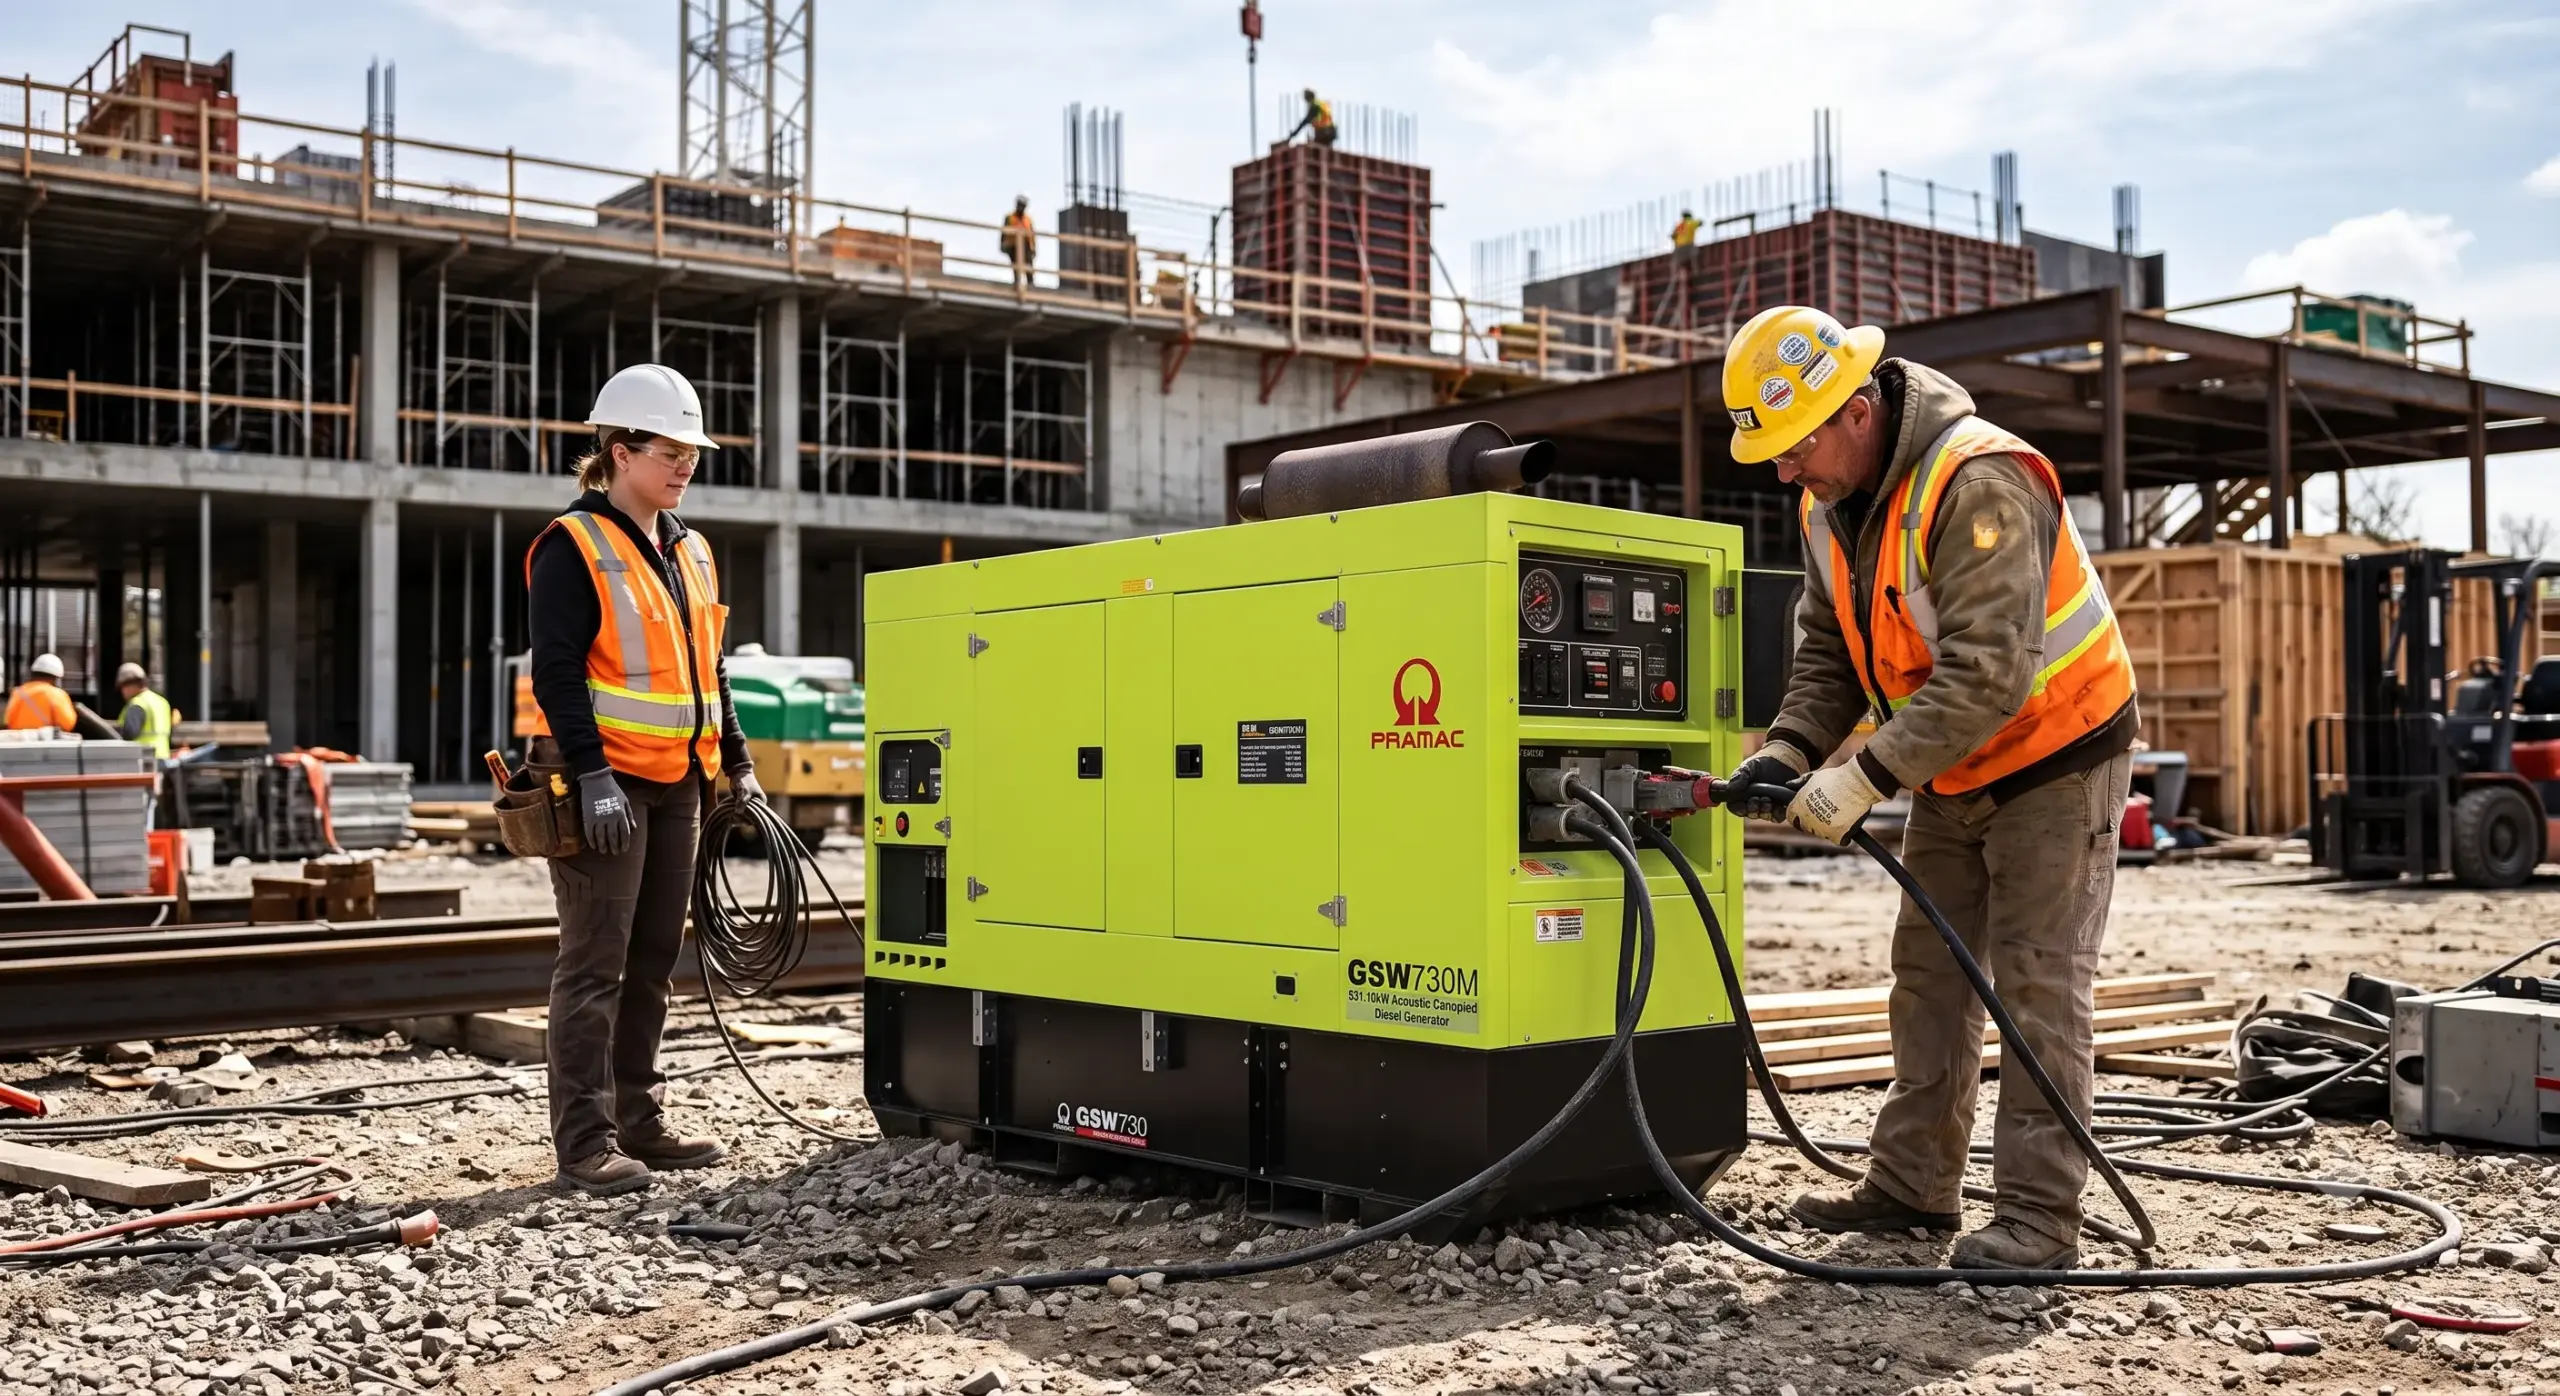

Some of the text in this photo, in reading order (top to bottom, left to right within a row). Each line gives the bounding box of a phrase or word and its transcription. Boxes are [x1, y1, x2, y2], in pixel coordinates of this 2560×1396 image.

[1371, 730, 1465, 749] PRAMAC
[1348, 959, 1478, 997] GSW730M
[1348, 990, 1478, 1015] 531.10kW Acoustic Canopied
[1374, 1008, 1450, 1027] Diesel Generator
[1075, 1106, 1148, 1137] GSW730
